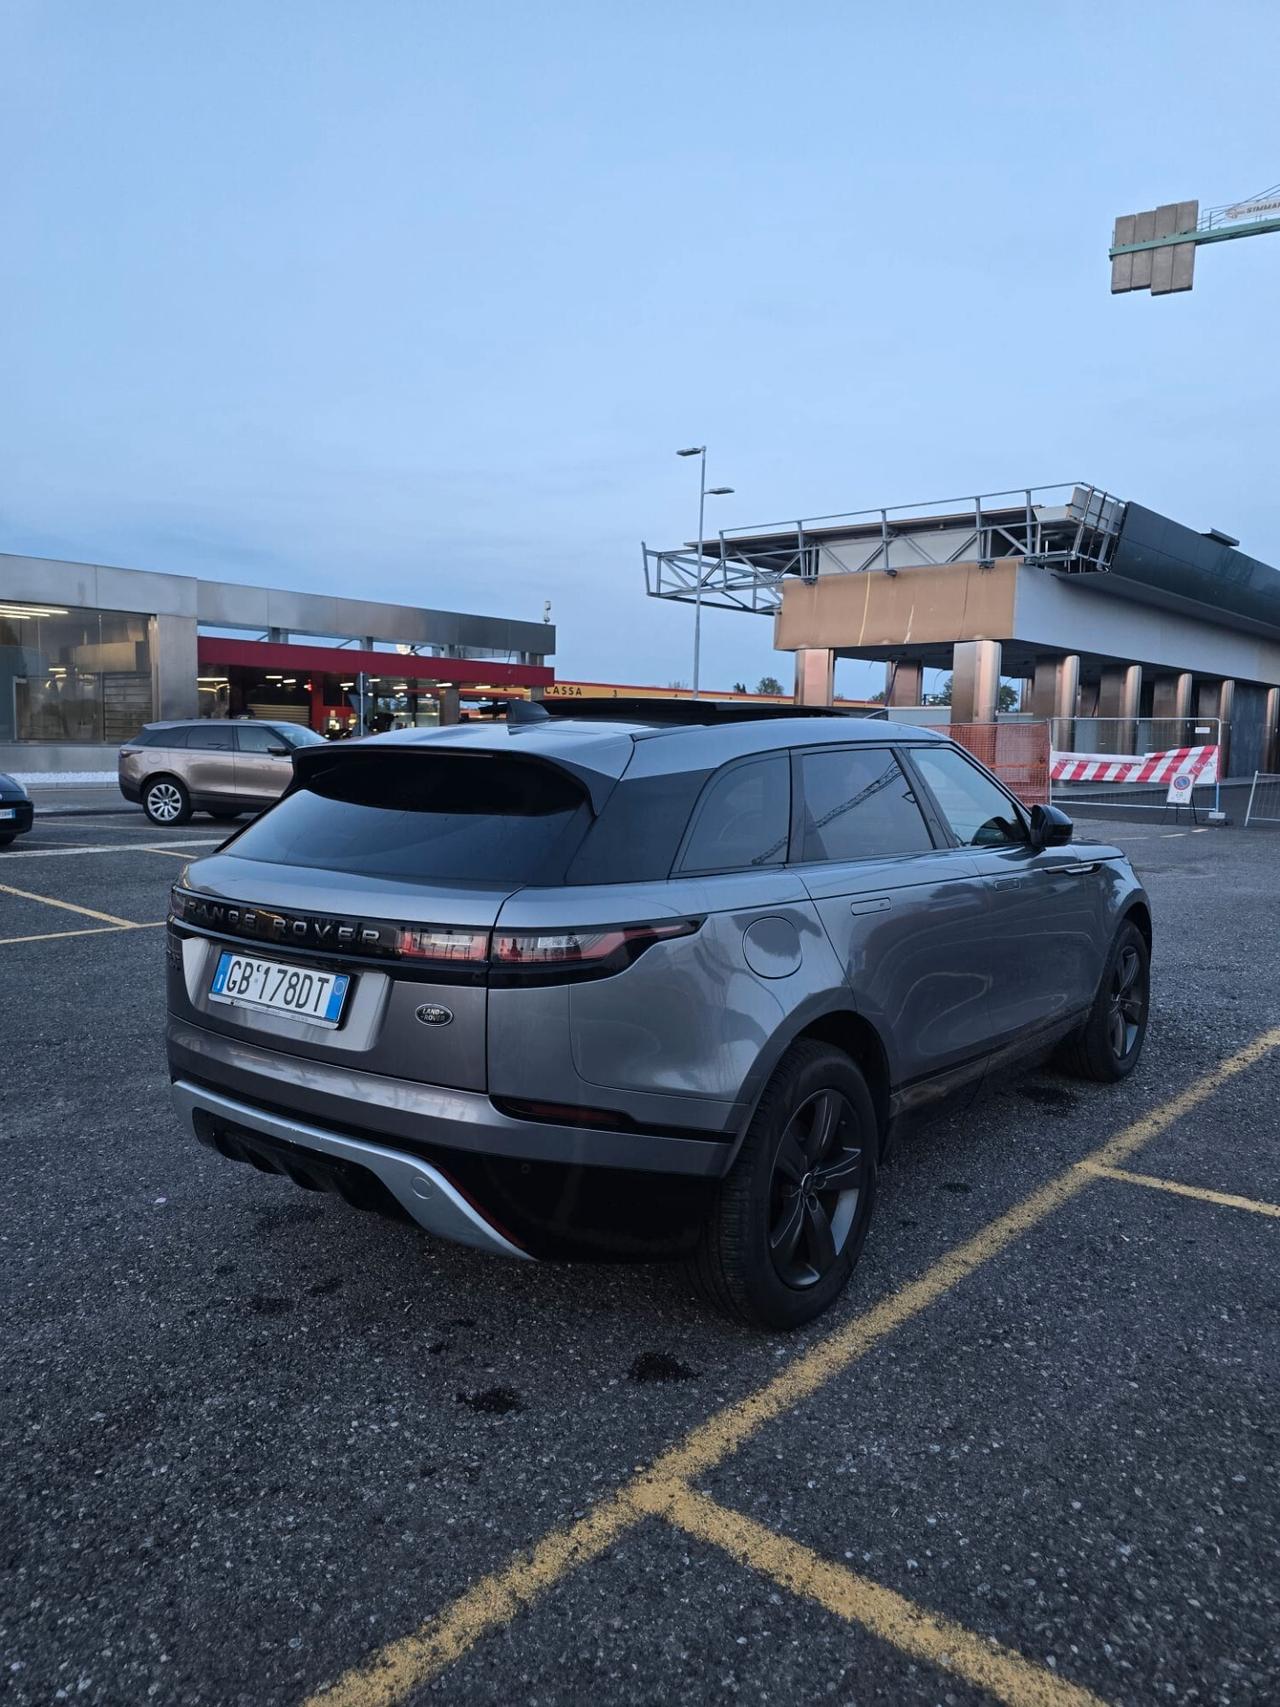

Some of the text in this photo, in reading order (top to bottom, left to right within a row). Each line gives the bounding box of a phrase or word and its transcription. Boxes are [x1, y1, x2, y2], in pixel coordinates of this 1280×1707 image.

[545, 686, 583, 696] CASSA
[188, 901, 380, 944] RANGE ROVER
